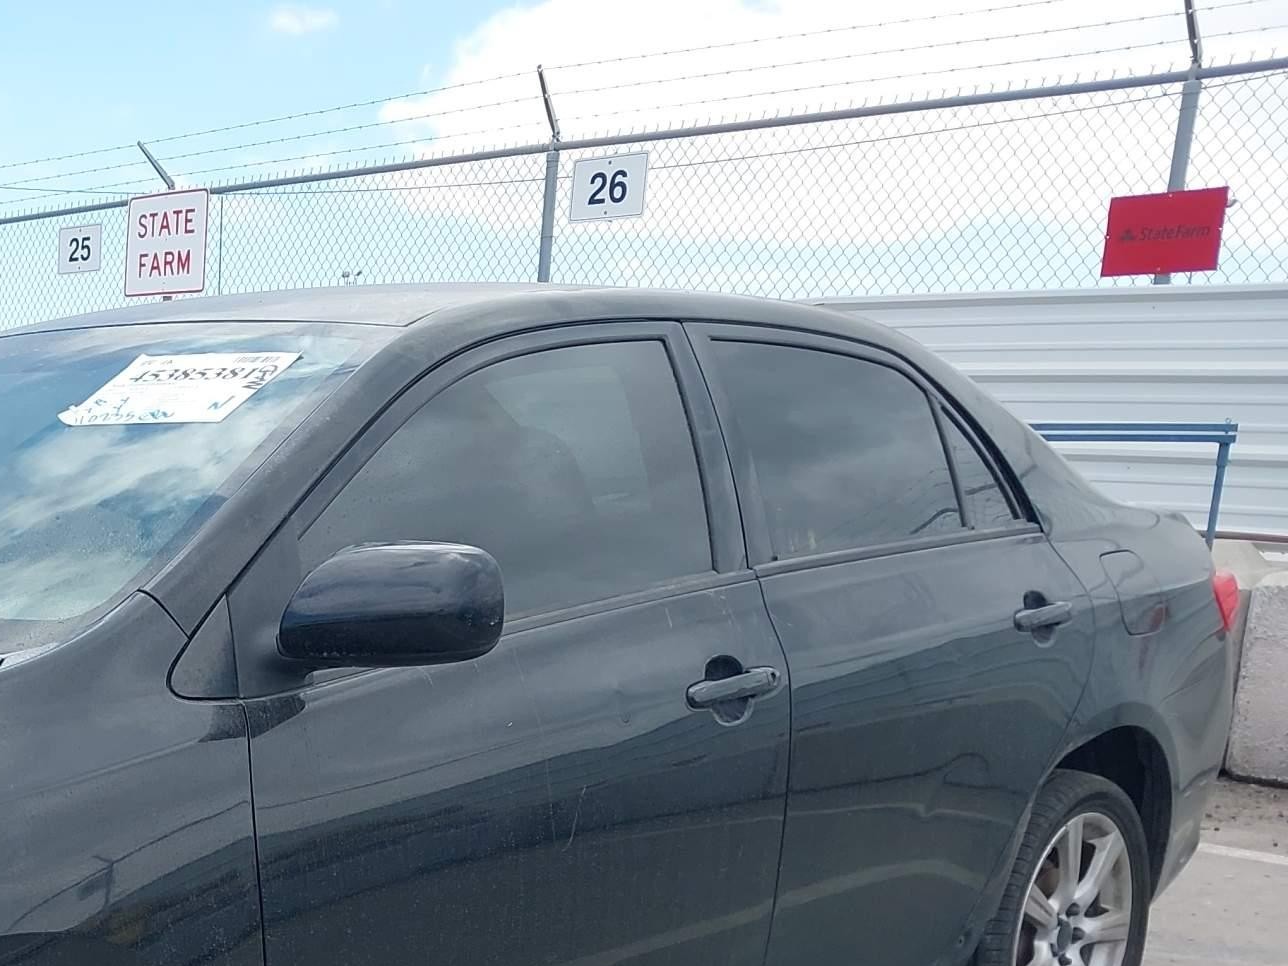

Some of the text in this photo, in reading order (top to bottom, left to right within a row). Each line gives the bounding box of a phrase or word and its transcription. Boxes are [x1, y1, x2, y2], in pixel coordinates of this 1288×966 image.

[588, 169, 628, 206] 26
[137, 208, 196, 239] STATE
[68, 236, 91, 262] 25
[138, 249, 191, 279] FARM
